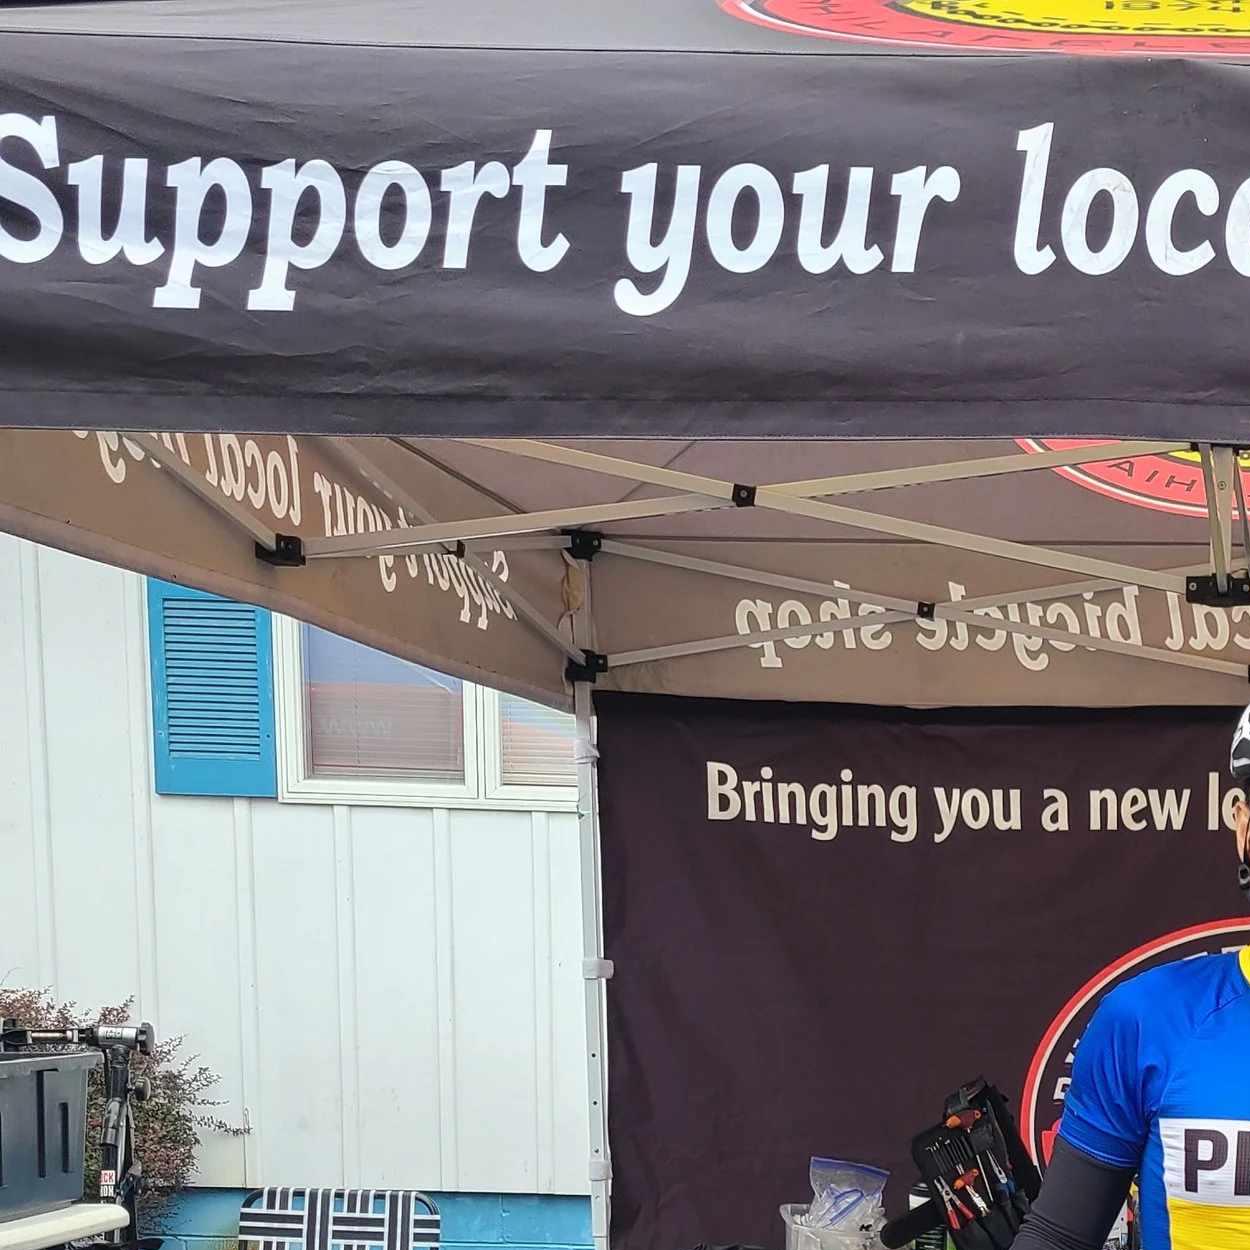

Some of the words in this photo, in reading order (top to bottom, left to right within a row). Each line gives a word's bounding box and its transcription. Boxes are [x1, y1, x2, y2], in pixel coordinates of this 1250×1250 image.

[0, 113, 571, 312] Support
[613, 161, 961, 317] your
[706, 761, 917, 843] Bringing
[933, 787, 1022, 843] you
[1041, 787, 1070, 832] a
[1089, 787, 1191, 832] new
